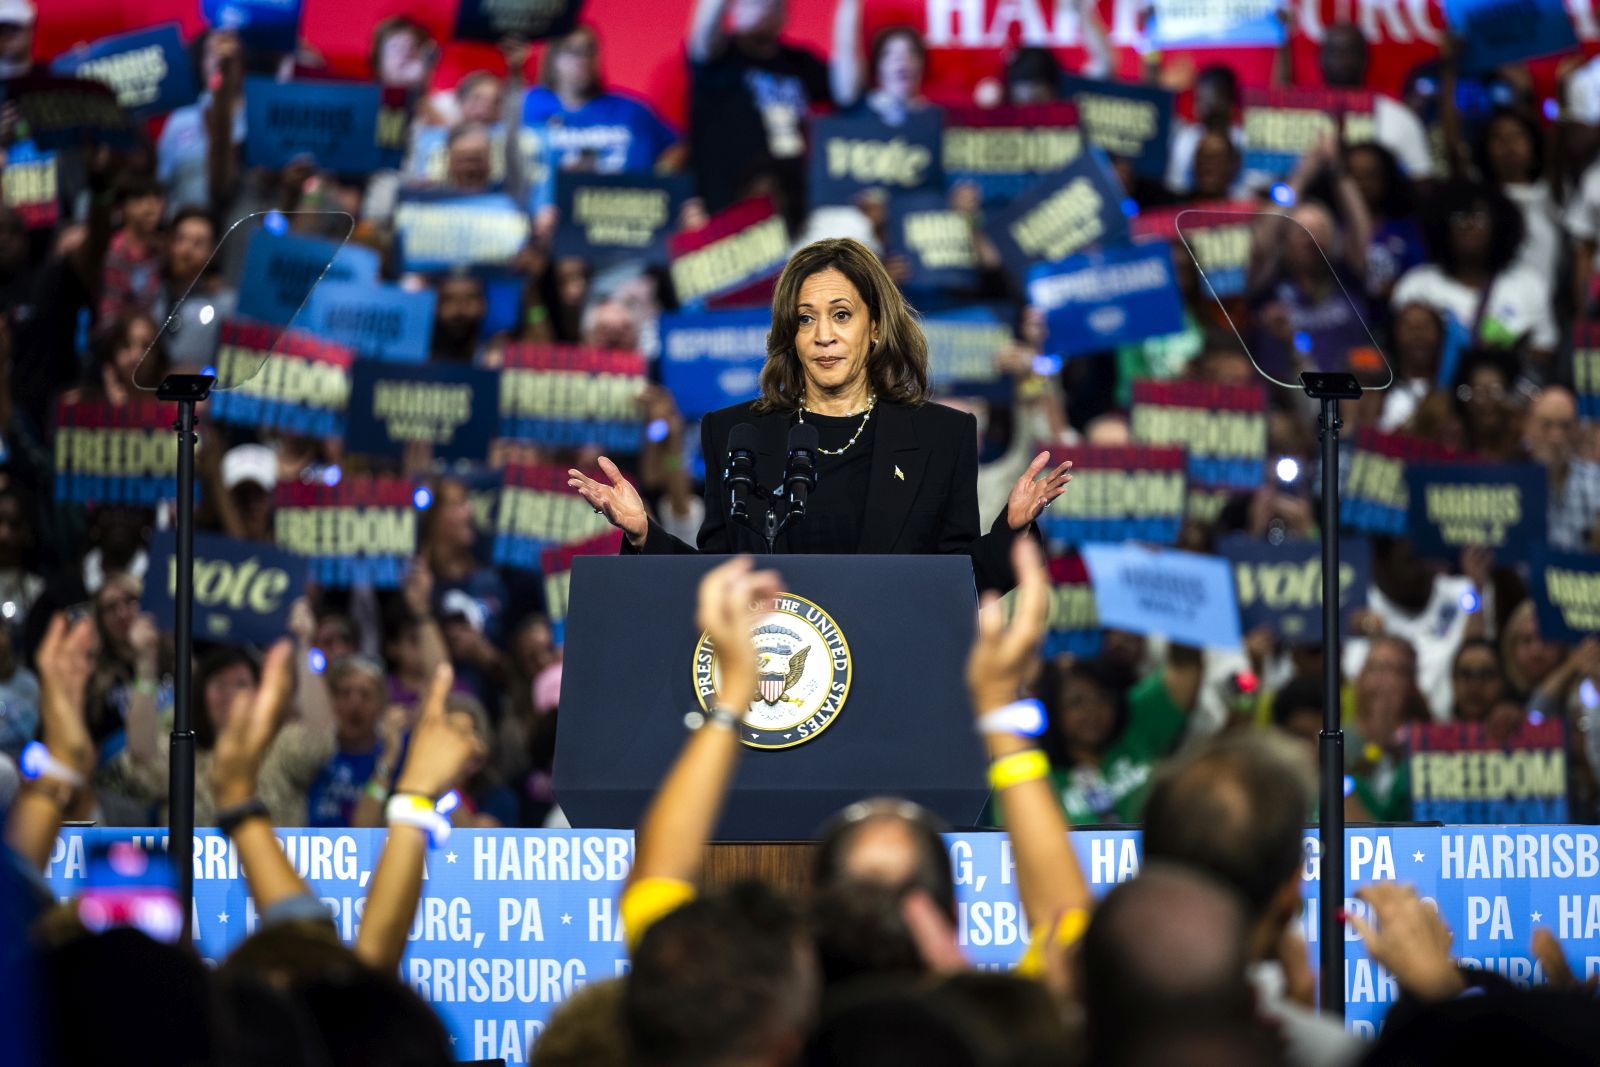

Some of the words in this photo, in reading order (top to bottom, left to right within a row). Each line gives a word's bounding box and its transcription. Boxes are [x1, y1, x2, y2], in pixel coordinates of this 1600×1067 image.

[56, 426, 200, 477] FREEDO
[275, 506, 417, 557] FREEDOM
[773, 598, 800, 614] THE
[804, 606, 848, 671] UNITED
[796, 680, 847, 738] STATES
[1411, 750, 1567, 799] FREEDOM
[1350, 836, 1396, 880] PA
[499, 897, 544, 942] PA
[1467, 895, 1514, 941] PA
